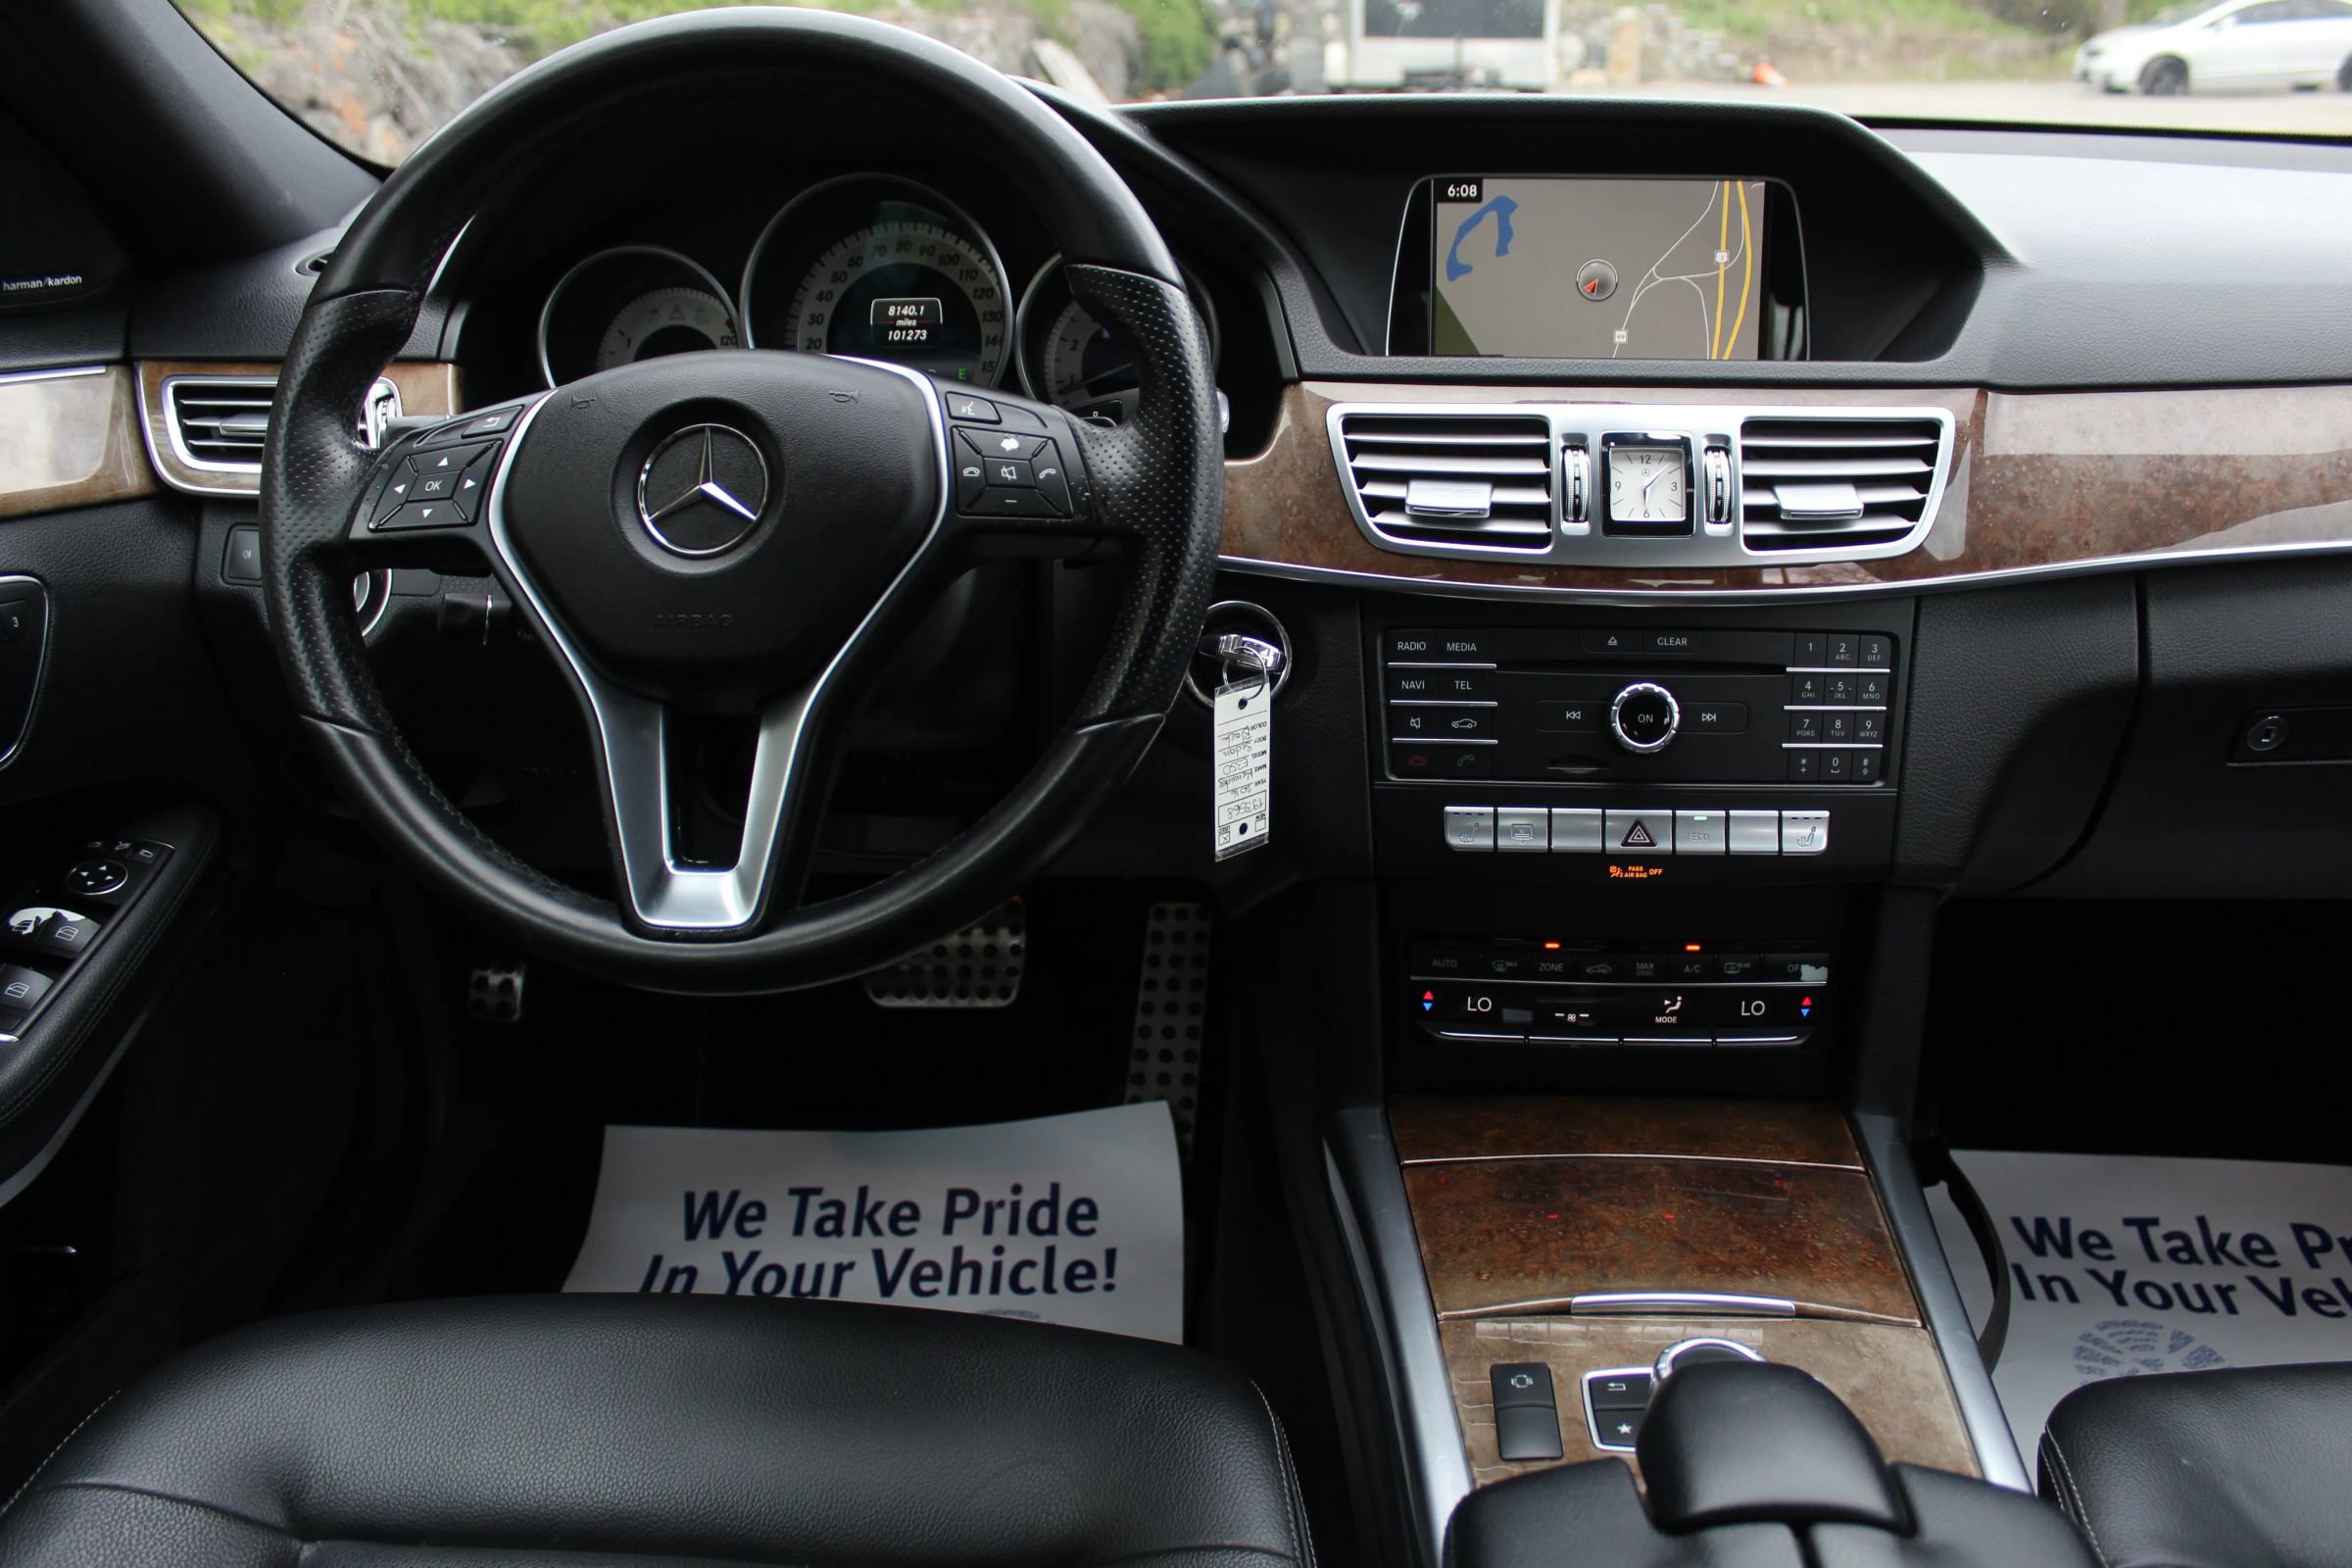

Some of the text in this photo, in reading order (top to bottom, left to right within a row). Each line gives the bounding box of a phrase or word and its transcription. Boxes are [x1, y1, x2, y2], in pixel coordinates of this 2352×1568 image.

[1447, 184, 1478, 198] 6:08
[870, 244, 887, 257] 70
[896, 240, 912, 252] 80
[918, 244, 935, 257] 90
[847, 256, 863, 268] 60
[938, 254, 959, 266] 100
[830, 270, 848, 283] 50
[958, 269, 978, 280] 110
[2, 274, 82, 291] harman/kardon
[815, 290, 834, 303] 40
[972, 287, 994, 299] 120
[888, 305, 925, 317] 8140.1
[982, 311, 1003, 322] 130
[807, 313, 824, 325] 30
[896, 318, 917, 326] miles
[887, 329, 928, 342] 101273
[805, 337, 822, 350] 20
[1069, 338, 1079, 352] 2
[956, 368, 967, 380] E
[1640, 454, 1651, 465] 12
[424, 479, 444, 492] OK
[1614, 481, 1622, 491] 9
[1670, 481, 1678, 492] 3
[1642, 509, 1650, 518] 6
[12, 615, 20, 628] 3
[1396, 641, 1427, 651] RADIO
[1446, 642, 1477, 652] MEDIA
[1656, 636, 1688, 647] CLEAR
[1808, 642, 1814, 652] 1
[1839, 642, 1846, 653] 2
[1871, 643, 1879, 654] 3
[1401, 679, 1425, 690] NAVI
[1454, 680, 1473, 690] TEL
[1804, 680, 1812, 691] 4
[1838, 681, 1844, 691] 5
[1868, 682, 1876, 692] 6
[1638, 713, 1654, 723] ON
[1802, 718, 1810, 729] 7
[1835, 719, 1841, 729] 8
[1865, 719, 1872, 730] 9
[1222, 758, 1248, 776] E350
[1832, 757, 1839, 766] 0
[1691, 832, 1710, 841] ECO
[1432, 957, 1458, 968] AUTO
[1538, 962, 1564, 972] ZONE
[1788, 963, 1801, 973] OF
[1683, 964, 1702, 973] A/C
[1467, 996, 1493, 1012] LO
[1741, 1000, 1766, 1016] LO
[1654, 1015, 1678, 1024] MODE
[682, 1182, 1100, 1242] We Take Pride
[2009, 1215, 2116, 1261] We
[2122, 1215, 2282, 1269] Take
[638, 1246, 1118, 1299] In Your Vehicle!
[2009, 1263, 2080, 1304] In
[2083, 1268, 2239, 1315] Your
